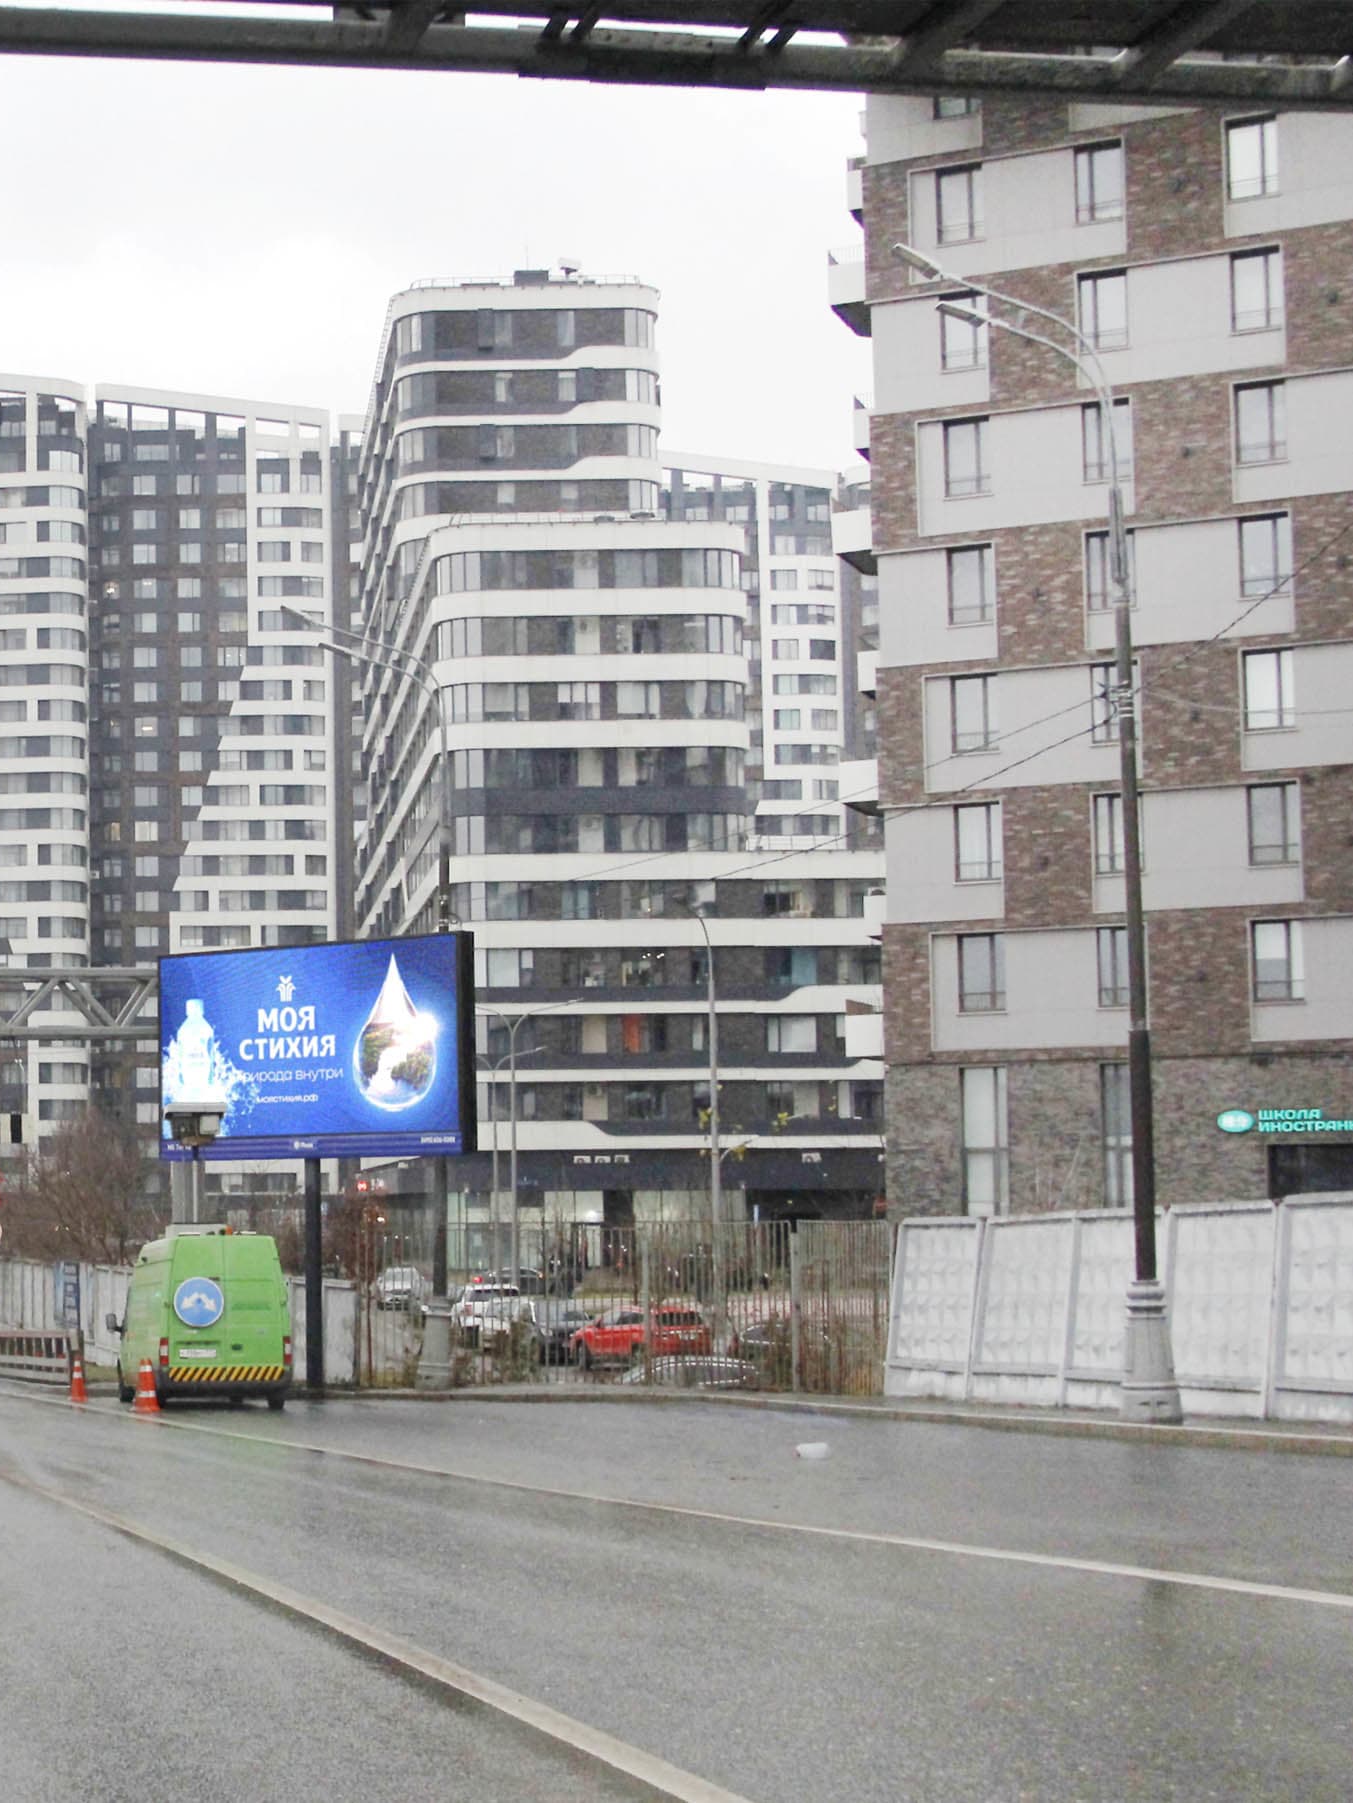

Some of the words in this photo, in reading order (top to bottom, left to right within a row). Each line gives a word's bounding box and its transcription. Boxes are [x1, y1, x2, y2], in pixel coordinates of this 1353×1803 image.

[257, 1006, 316, 1032] МОЯ
[239, 1035, 336, 1061] СТИХИЯ
[295, 1067, 344, 1082] внутри
[1257, 1108, 1321, 1121] ШКОЛА
